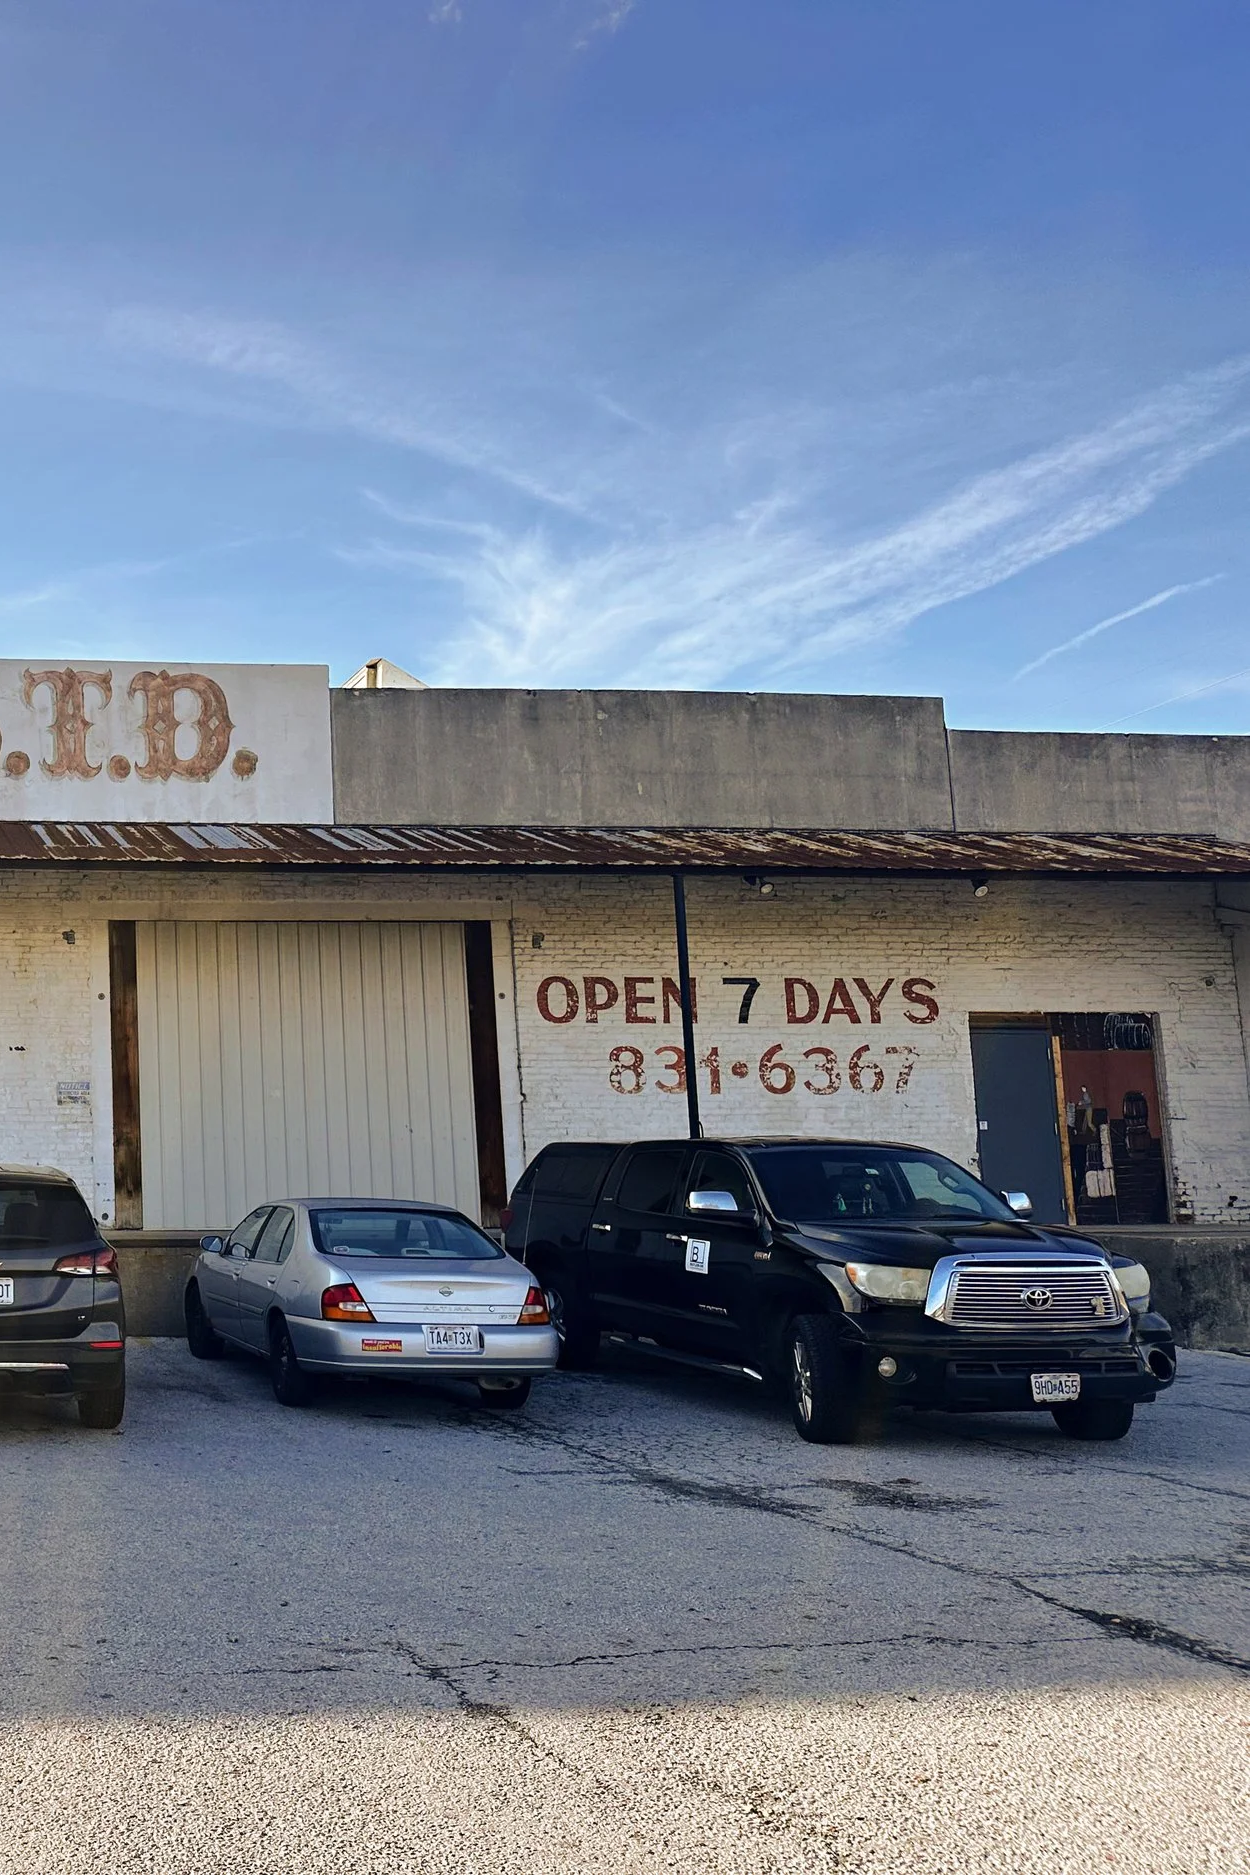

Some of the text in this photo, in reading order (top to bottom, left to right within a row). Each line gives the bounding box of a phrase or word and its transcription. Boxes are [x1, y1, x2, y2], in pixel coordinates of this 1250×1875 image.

[536, 975, 941, 1025] OPEN 7 DAYS
[429, 1331, 472, 1346] TA4 T3X
[1057, 1379, 1078, 1395] A55
